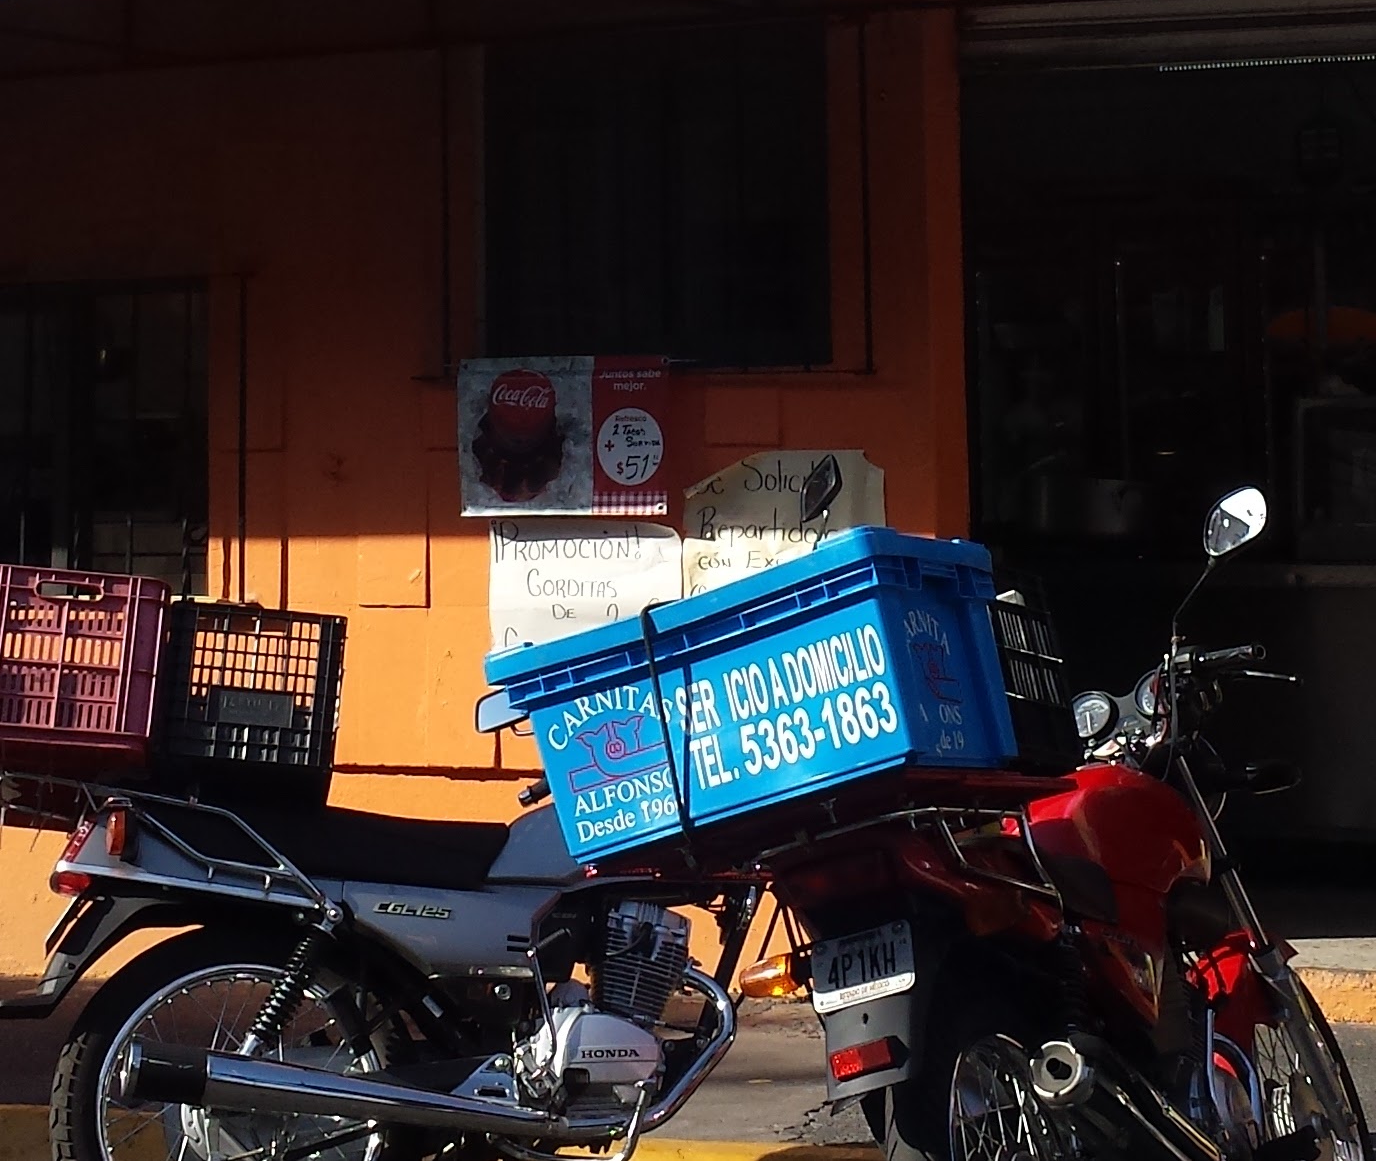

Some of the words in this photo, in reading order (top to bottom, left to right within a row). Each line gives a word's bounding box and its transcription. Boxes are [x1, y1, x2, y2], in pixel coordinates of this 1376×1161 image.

[492, 384, 551, 408] Coca-Cola
[527, 568, 618, 599] GORDITAS
[767, 657, 790, 710] A
[782, 624, 886, 704] DOMICILIO
[548, 685, 673, 750] CARNITAS
[689, 734, 740, 790] TEL.
[740, 681, 898, 776] 5363-1863
[575, 808, 637, 844] Desde
[828, 941, 896, 989] 4P1KH
[581, 1049, 639, 1059] HONDA
